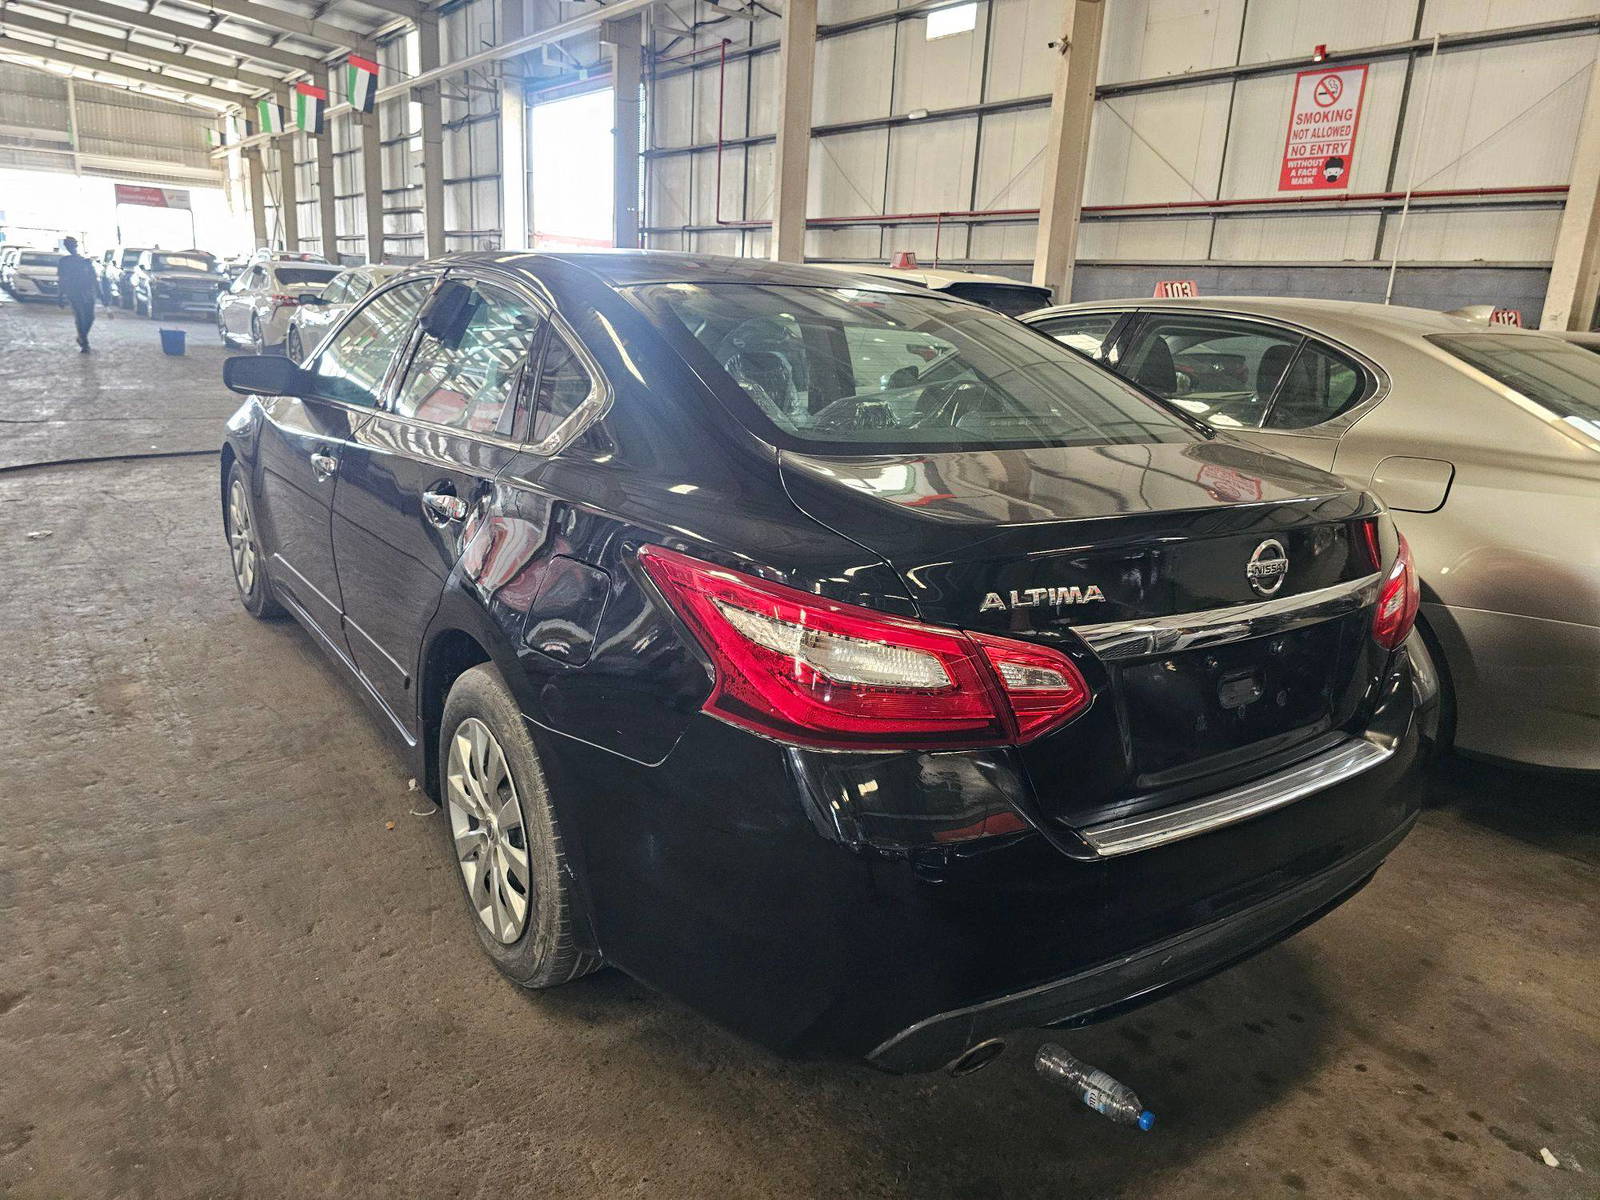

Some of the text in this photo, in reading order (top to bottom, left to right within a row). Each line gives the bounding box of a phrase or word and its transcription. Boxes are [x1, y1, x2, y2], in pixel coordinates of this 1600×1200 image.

[1296, 109, 1353, 125] SMOKING
[1292, 125, 1351, 140] NOT ALLOWED
[1290, 143, 1347, 156] NO ENTRY
[1287, 159, 1323, 168] WITHOUT
[1290, 168, 1318, 176] A FACE
[1290, 176, 1314, 184] MASK
[1165, 282, 1192, 298] 103
[1497, 311, 1517, 325] 112
[979, 585, 1106, 612] ALTIMA
